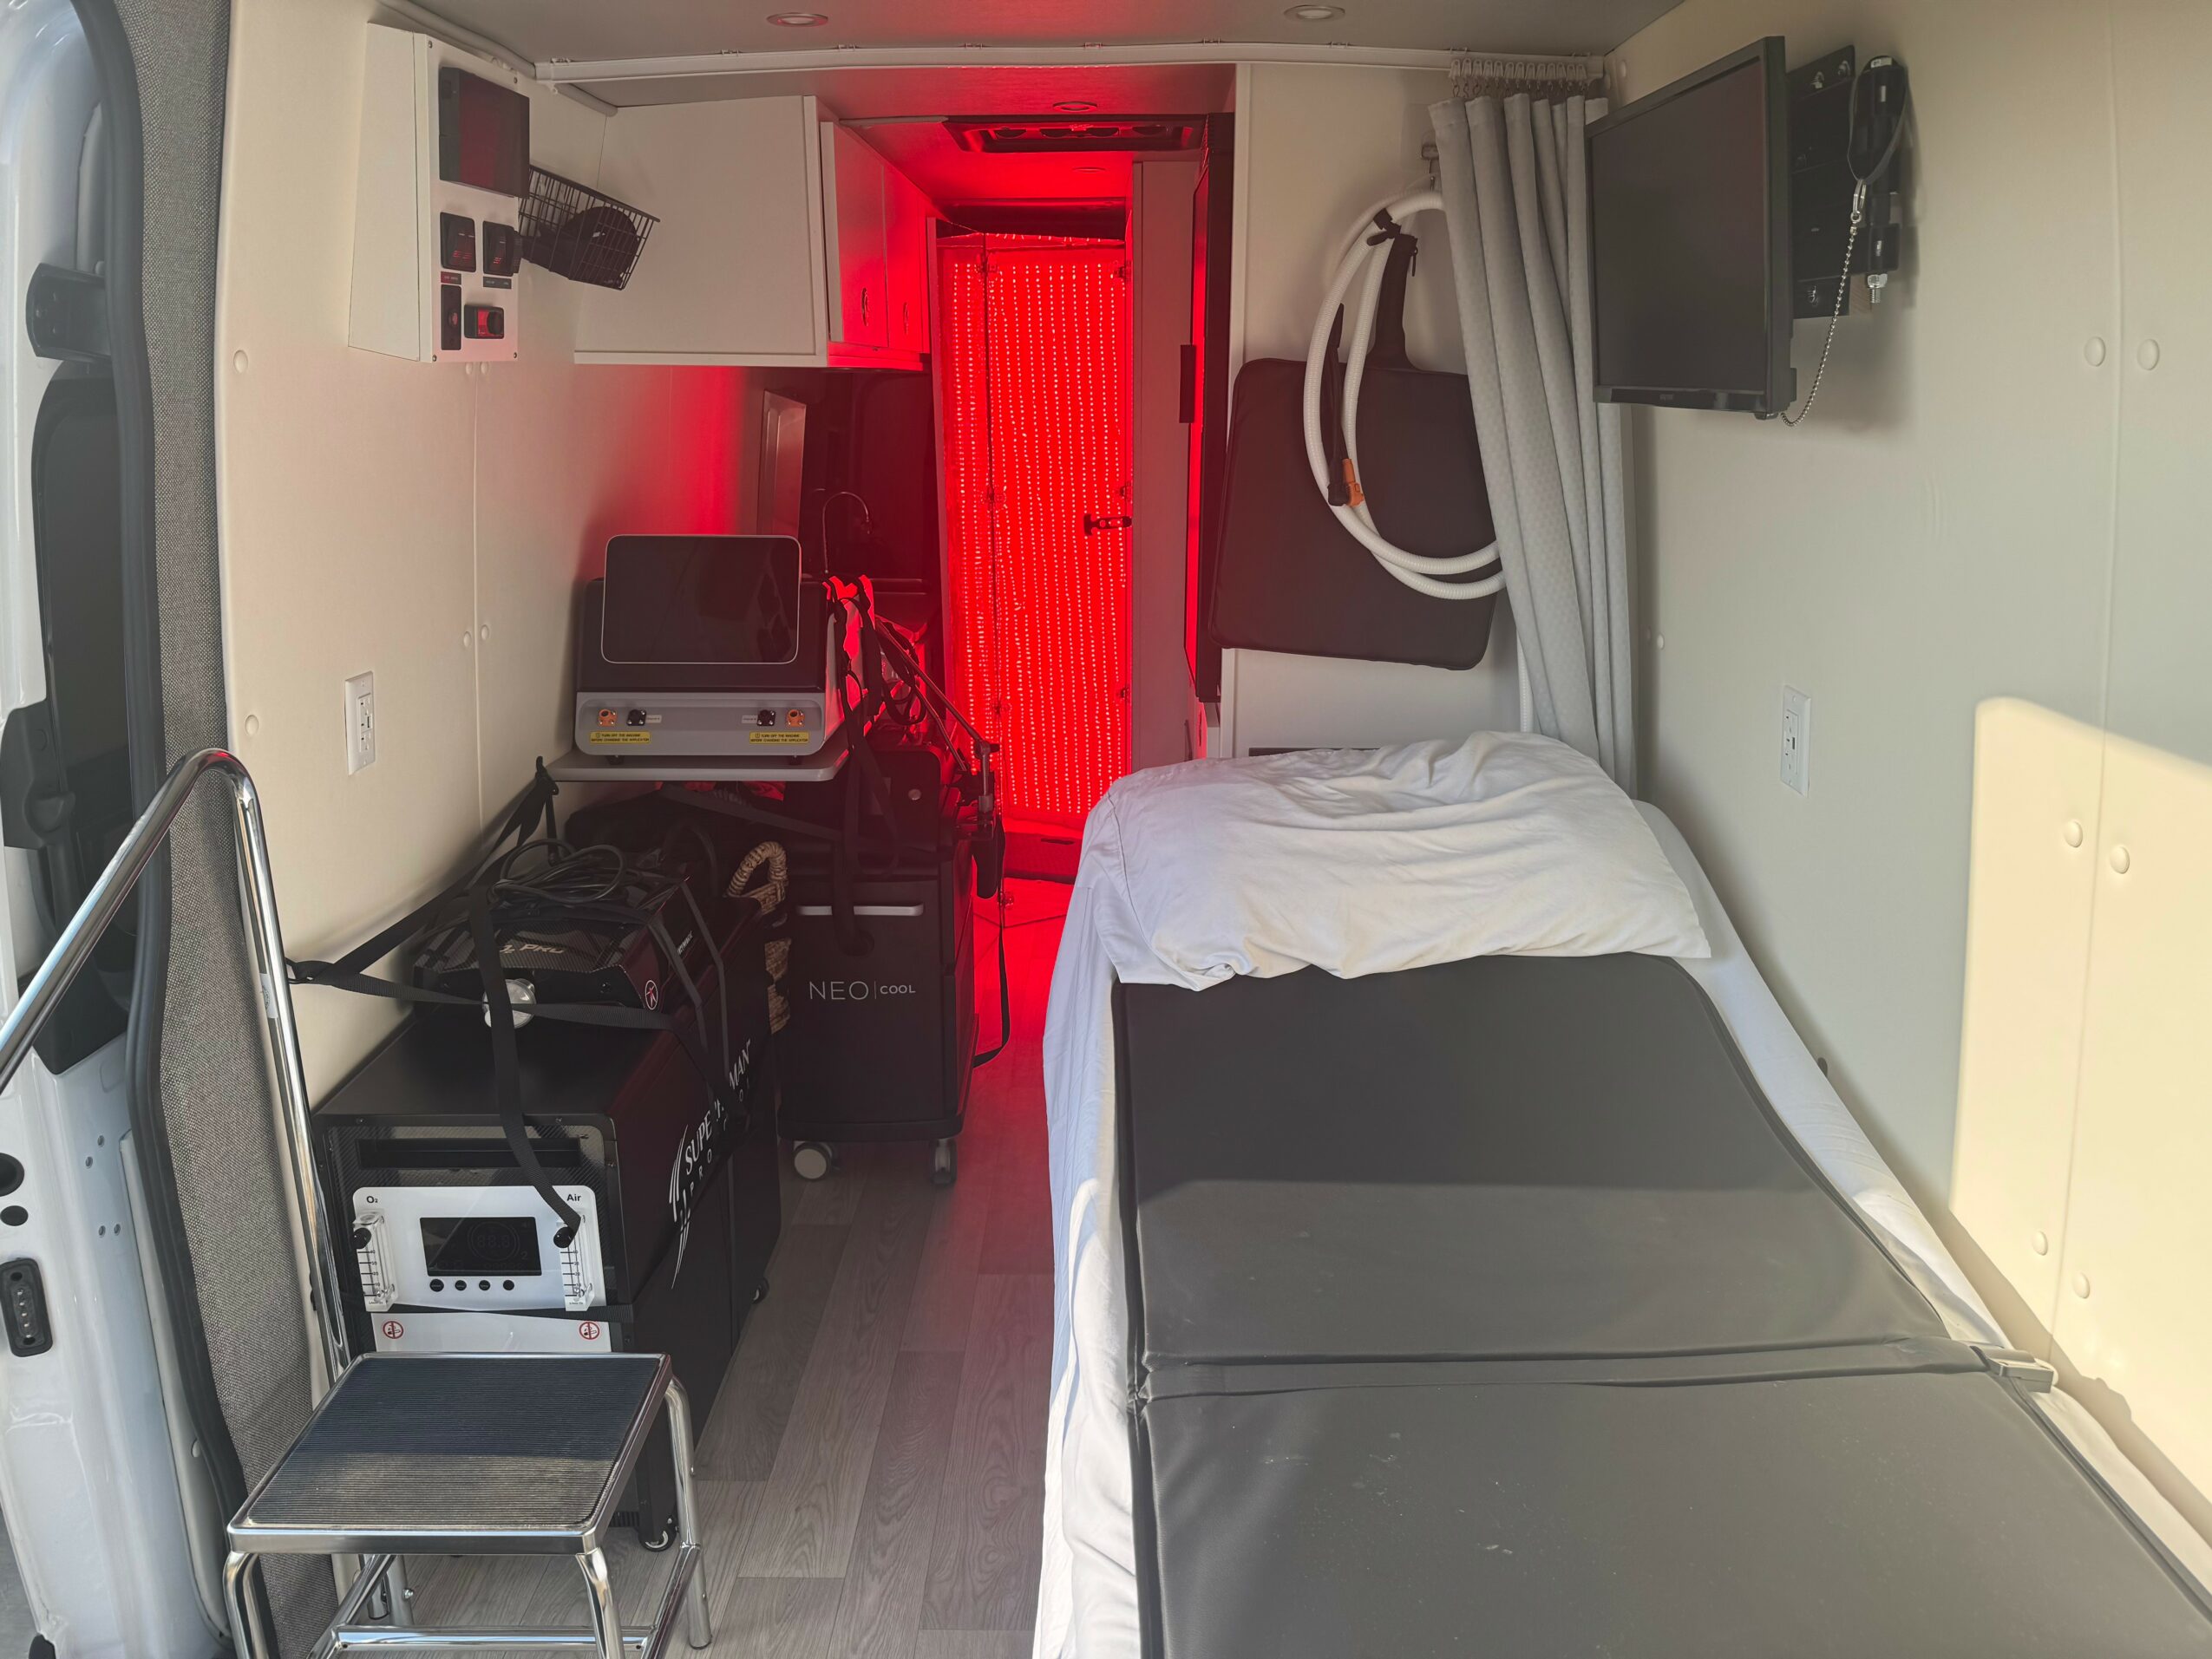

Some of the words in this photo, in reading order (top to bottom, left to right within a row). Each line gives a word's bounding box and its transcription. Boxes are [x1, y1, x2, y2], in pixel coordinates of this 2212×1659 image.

[808, 981, 869, 1000] NEO
[880, 984, 916, 995] COOL
[566, 1193, 582, 1202] Air
